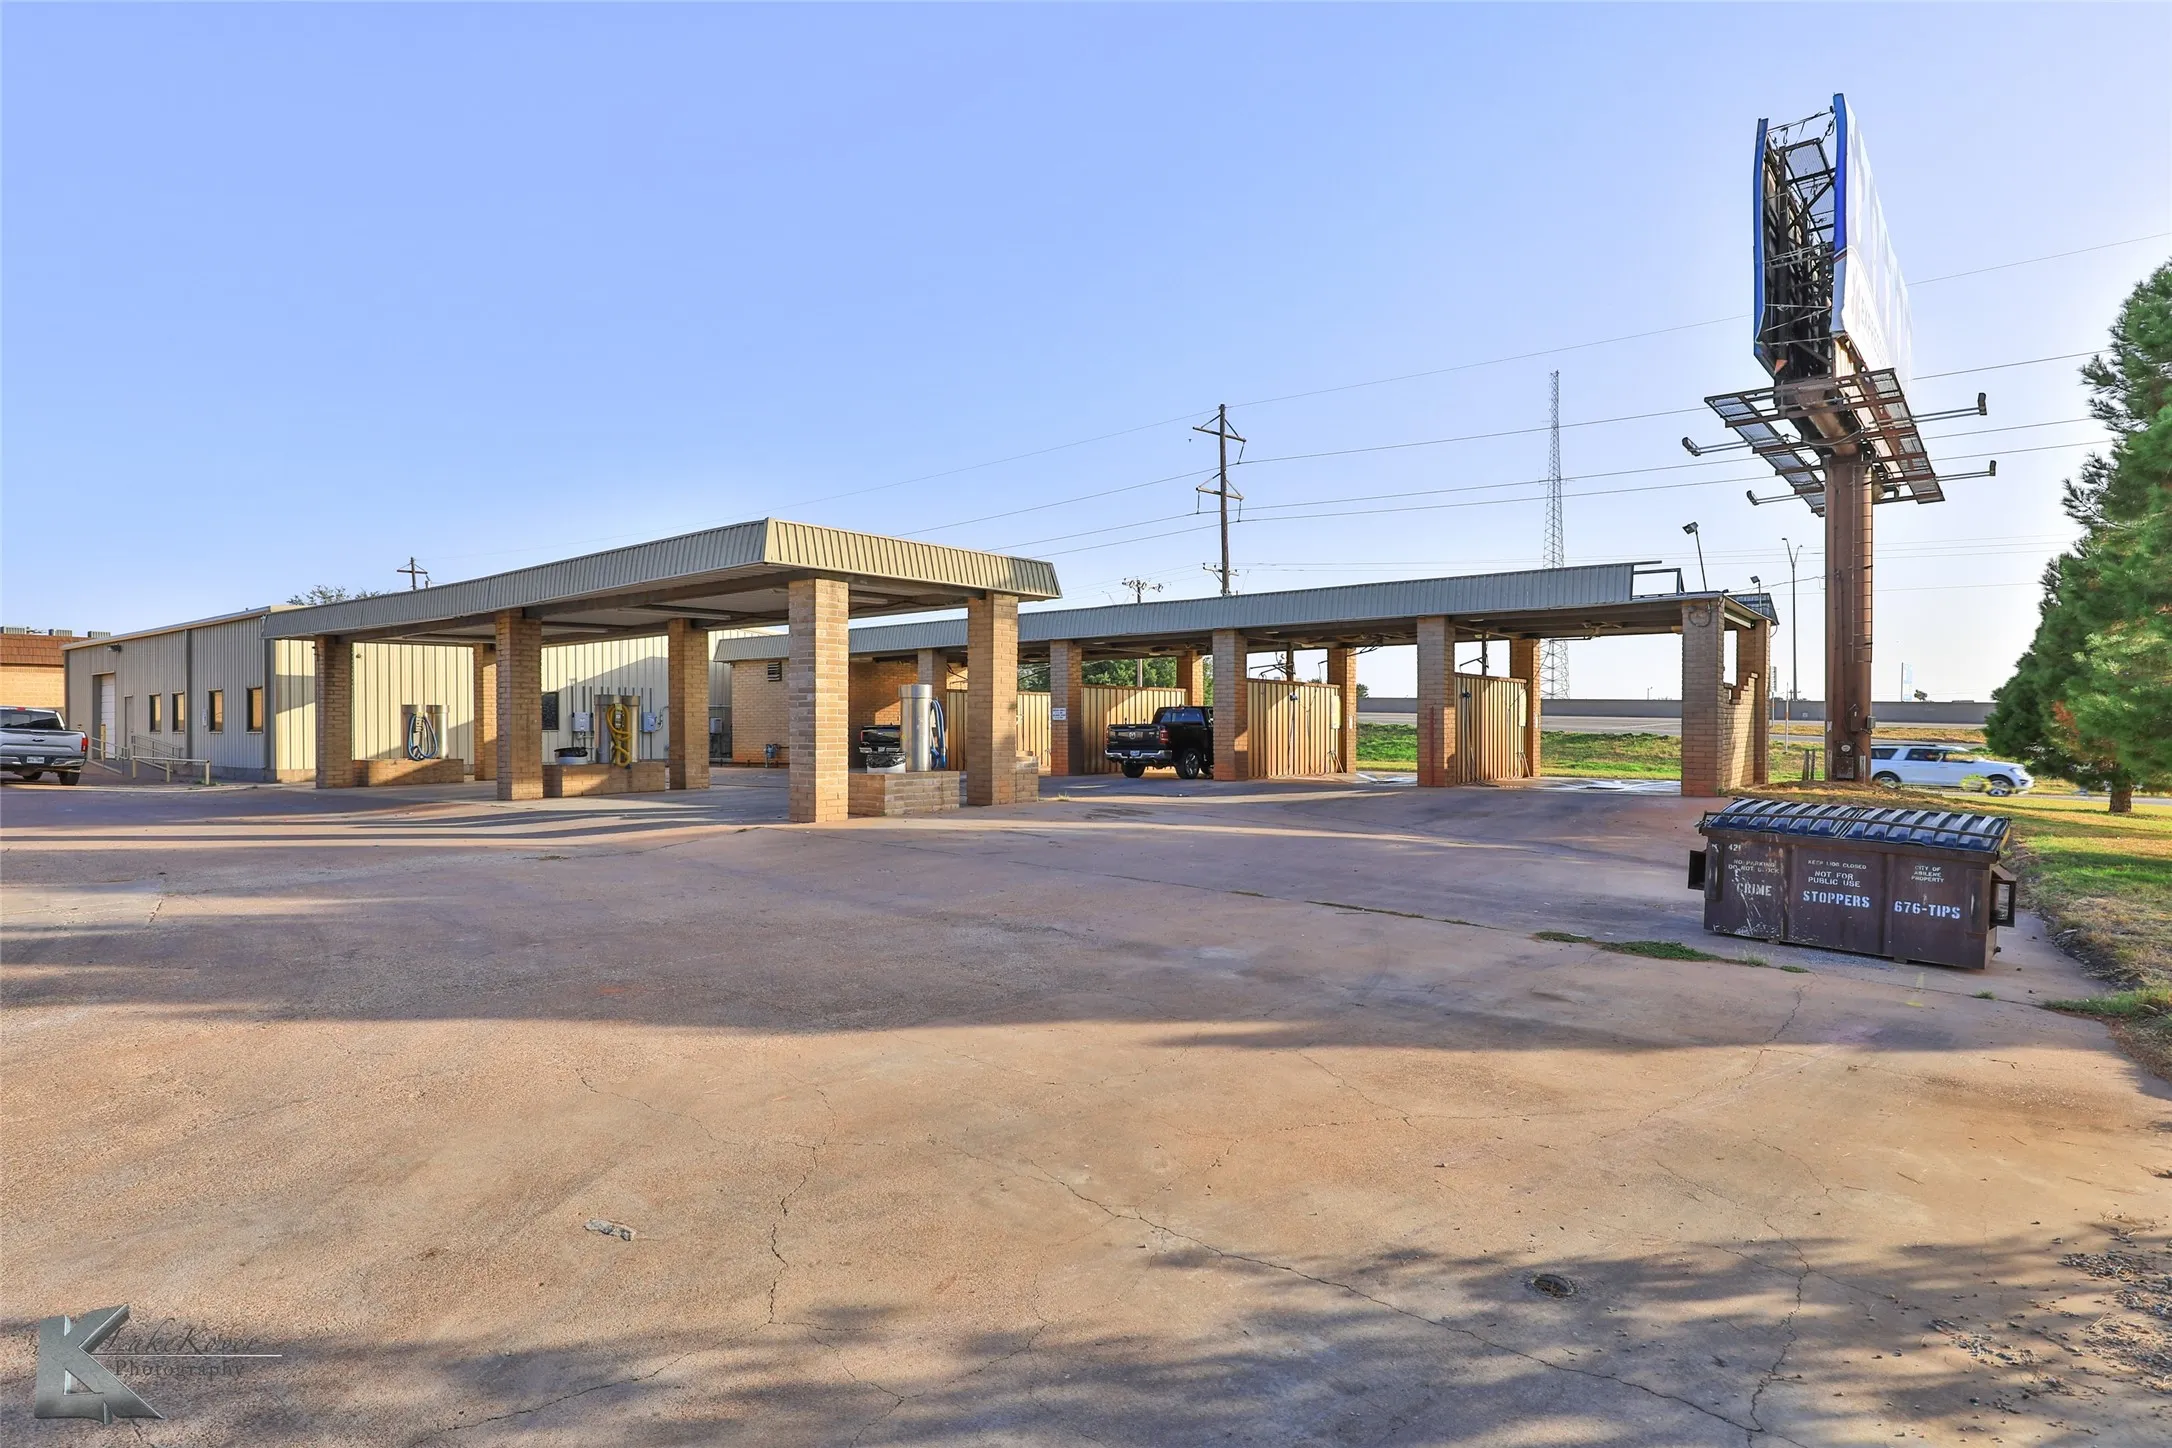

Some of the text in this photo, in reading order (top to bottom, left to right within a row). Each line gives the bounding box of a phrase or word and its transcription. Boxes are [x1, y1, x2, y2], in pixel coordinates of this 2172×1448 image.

[1746, 860, 1776, 868] PARKING
[1842, 862, 1867, 870] CLOSED
[1814, 870, 1854, 881] NOT FOR
[1910, 875, 1945, 883] PROPERTY
[1913, 870, 1942, 878] ABILENE
[1807, 876, 1861, 888] PUBLIC USE
[1736, 882, 1772, 897] CRIME
[1802, 890, 1870, 908] STOPPERS
[1894, 900, 1961, 919] 676-TIPS
